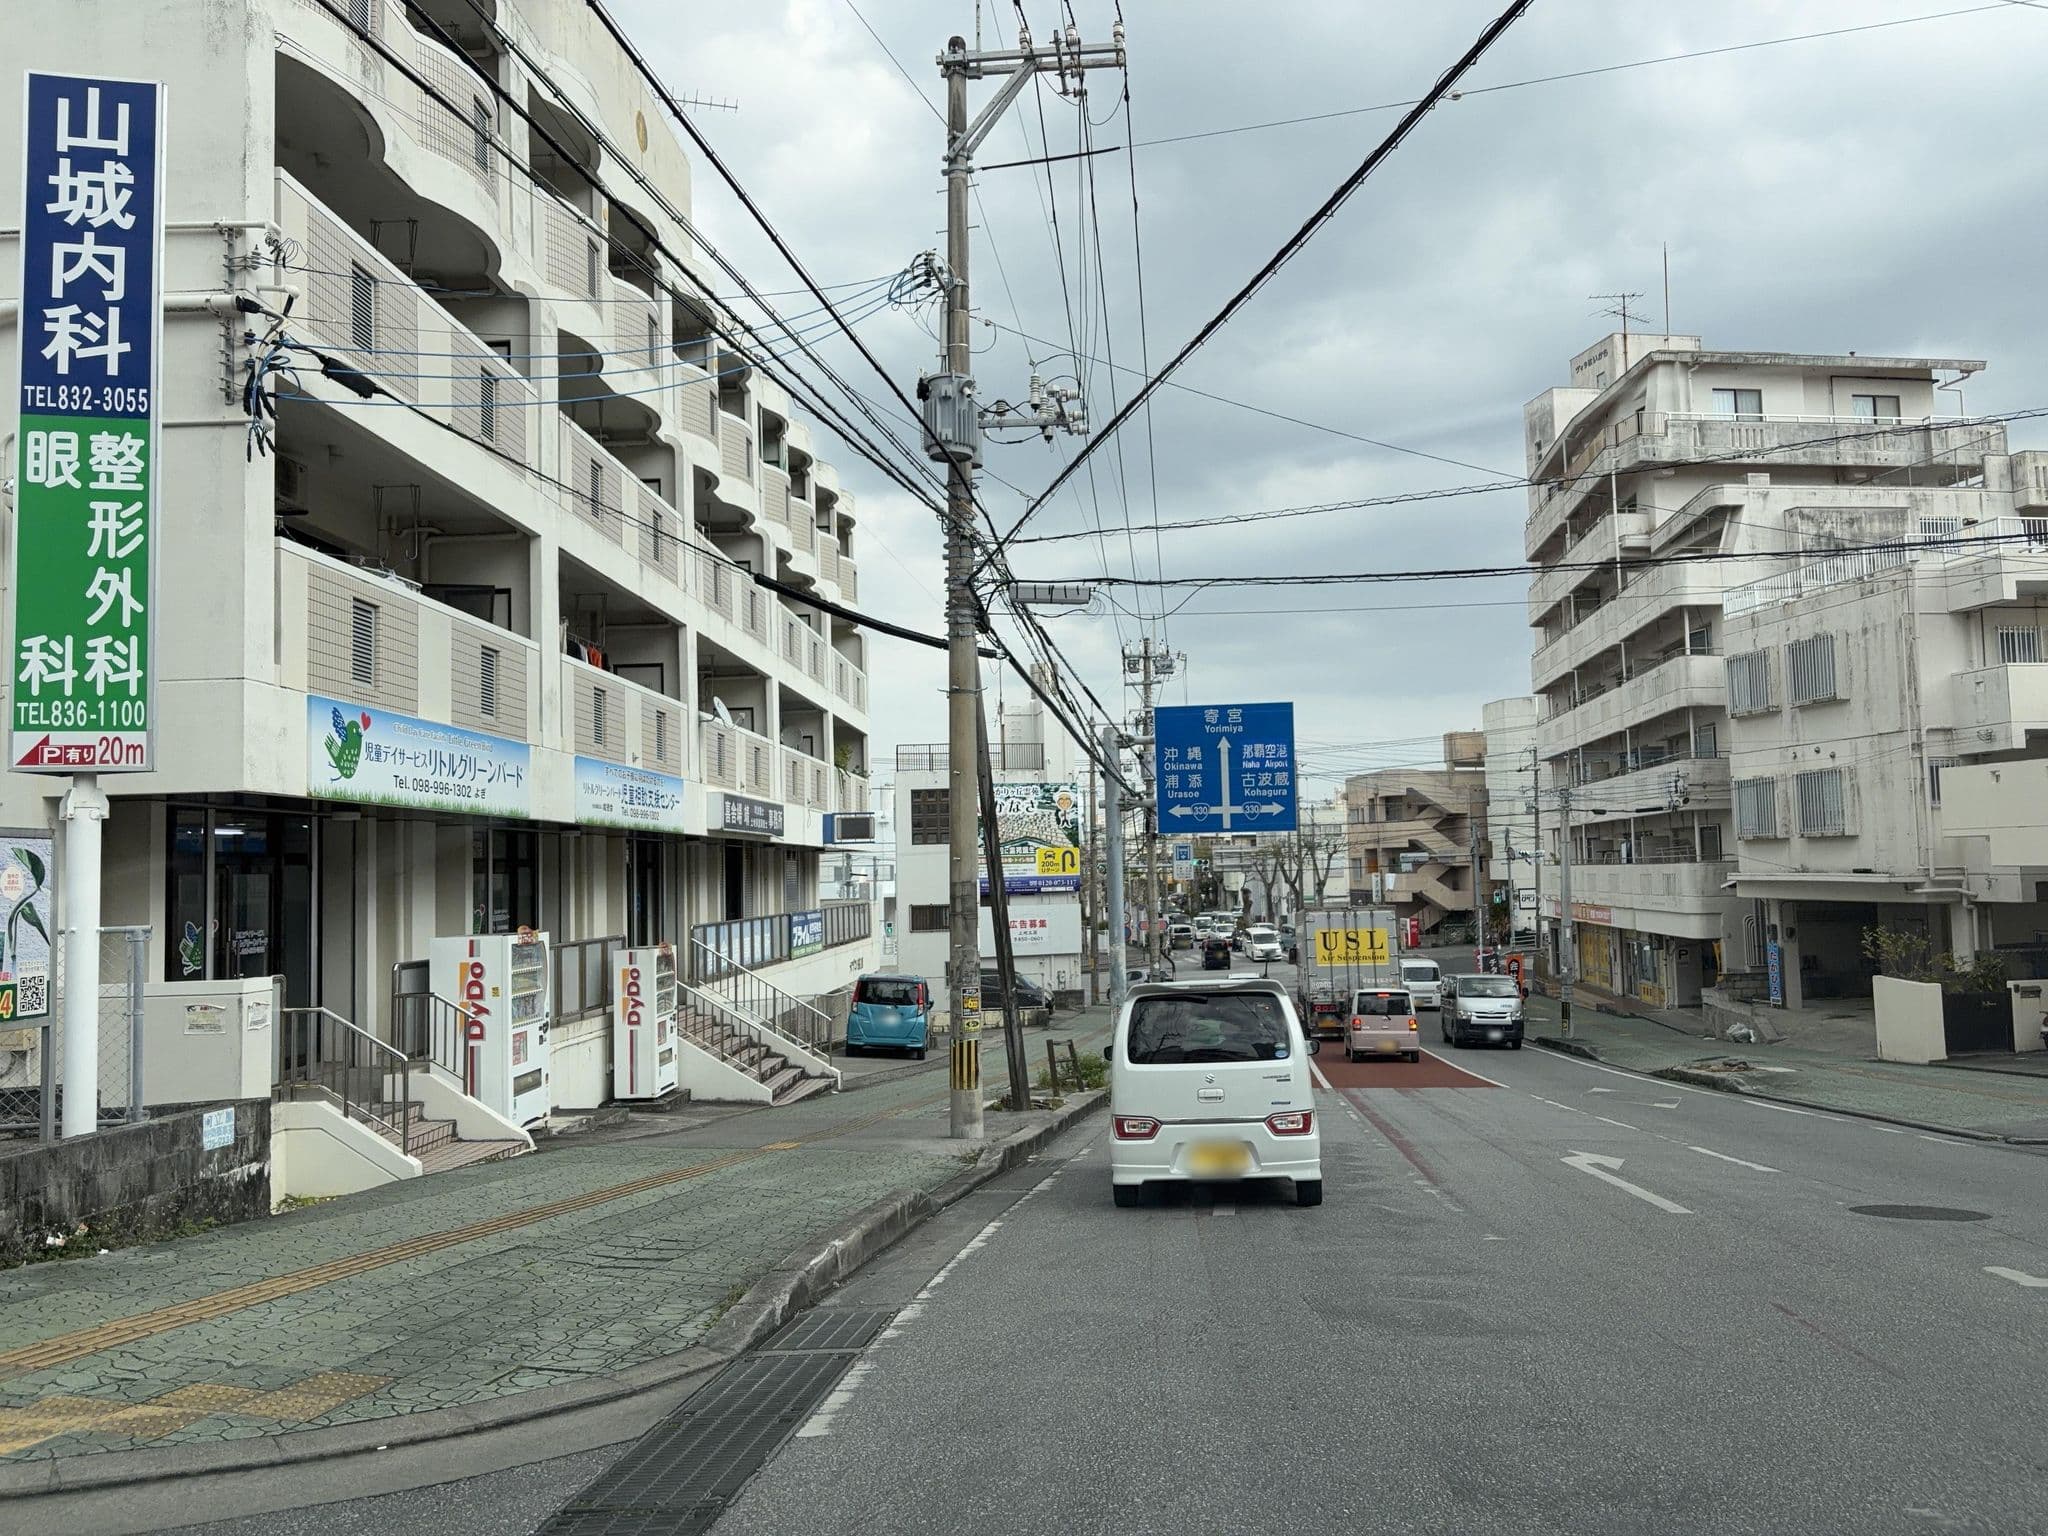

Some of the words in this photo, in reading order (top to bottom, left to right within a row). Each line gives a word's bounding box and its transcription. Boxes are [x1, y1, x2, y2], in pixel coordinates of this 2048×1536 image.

[41, 86, 136, 377] 山城内科
[85, 431, 146, 697] 整形外科
[1204, 708, 1243, 724] 寄宮
[1204, 724, 1243, 734] Yorimiya
[1163, 746, 1202, 761] 沖縄
[1242, 743, 1288, 759] 那覇空港
[1163, 762, 1203, 771] Okinawa
[1242, 760, 1261, 768] Naha
[1264, 759, 1288, 768] Airport
[393, 775, 410, 790] Tel.
[412, 778, 472, 798] 098-996-1302
[1164, 773, 1202, 789] 浦添
[1241, 771, 1290, 787] 古波蔵
[1167, 790, 1200, 799] Urasoe
[1244, 788, 1288, 798] Kohagura
[1193, 806, 1208, 814] 330
[1244, 805, 1259, 814] 330
[1041, 860, 1060, 868] 200m
[1320, 930, 1384, 951] USL
[1320, 953, 1333, 962] Air
[1333, 953, 1386, 963] Suspension
[466, 961, 490, 1041] DyDo
[627, 967, 644, 1026] DyDo
